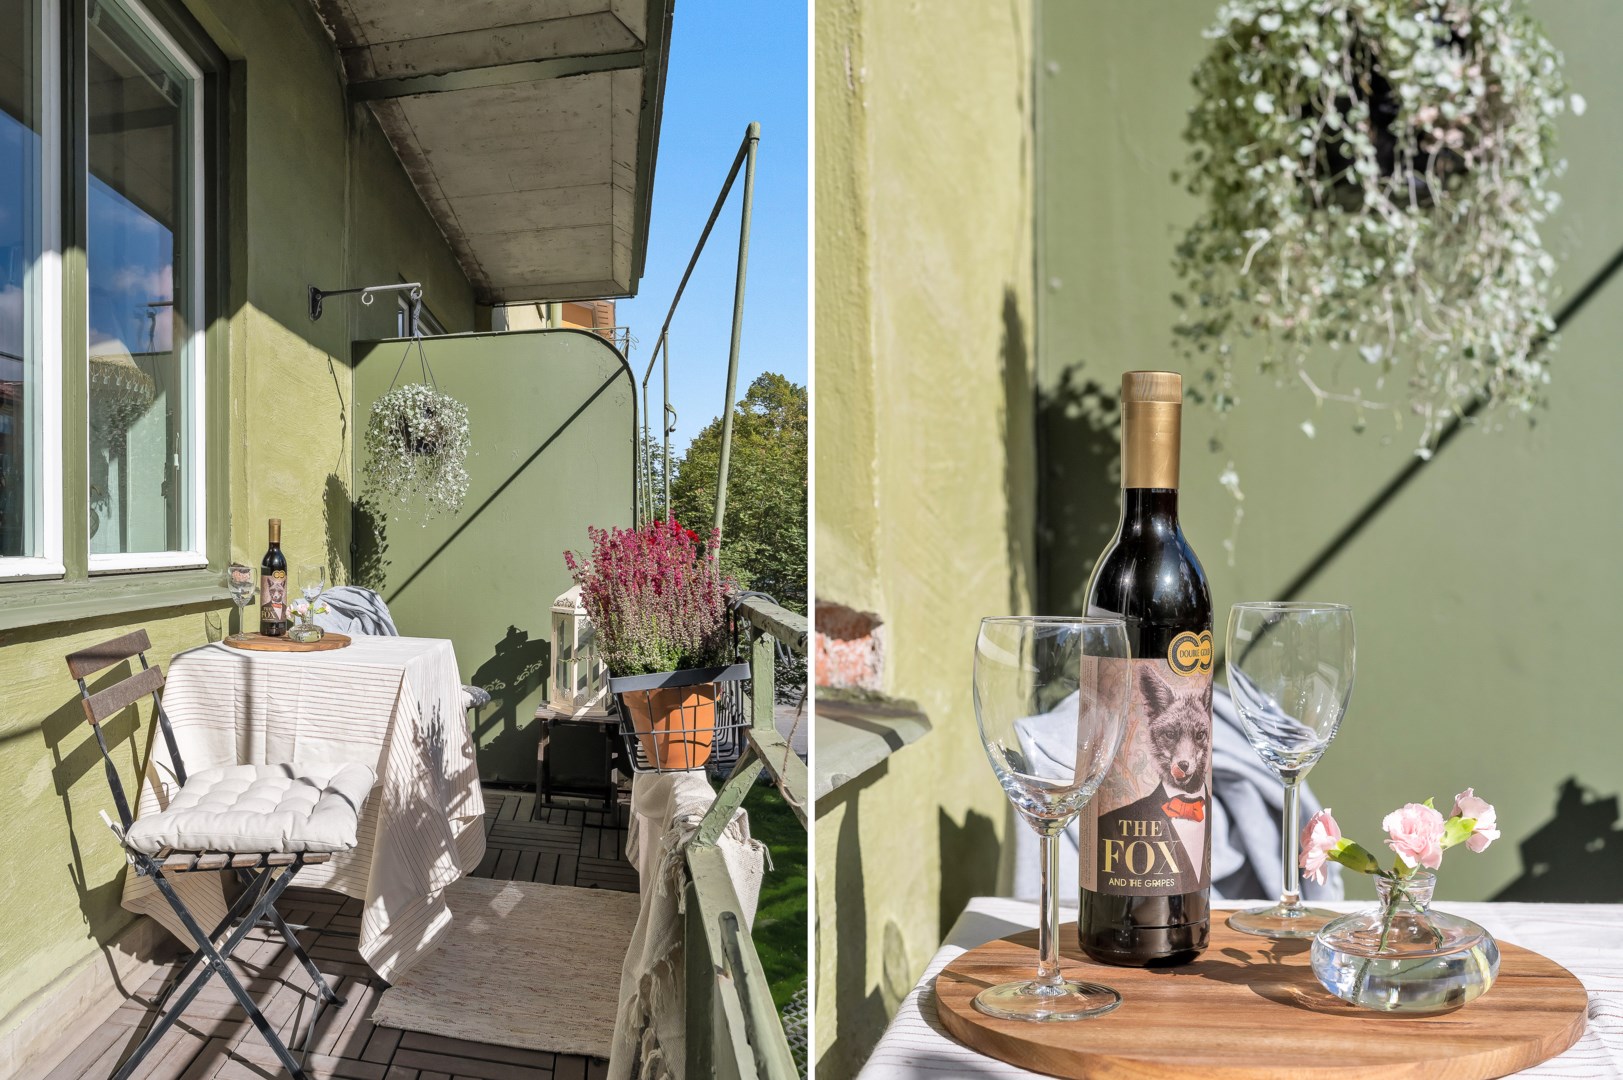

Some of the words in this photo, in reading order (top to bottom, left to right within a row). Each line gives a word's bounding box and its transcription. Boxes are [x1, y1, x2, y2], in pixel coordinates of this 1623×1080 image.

[1179, 649, 1199, 658] DOUBLE
[1118, 819, 1163, 837] THE
[1102, 838, 1184, 876] FOX
[1108, 877, 1127, 887] AND
[1129, 878, 1142, 888] THE
[1144, 878, 1175, 888] GRAPES
